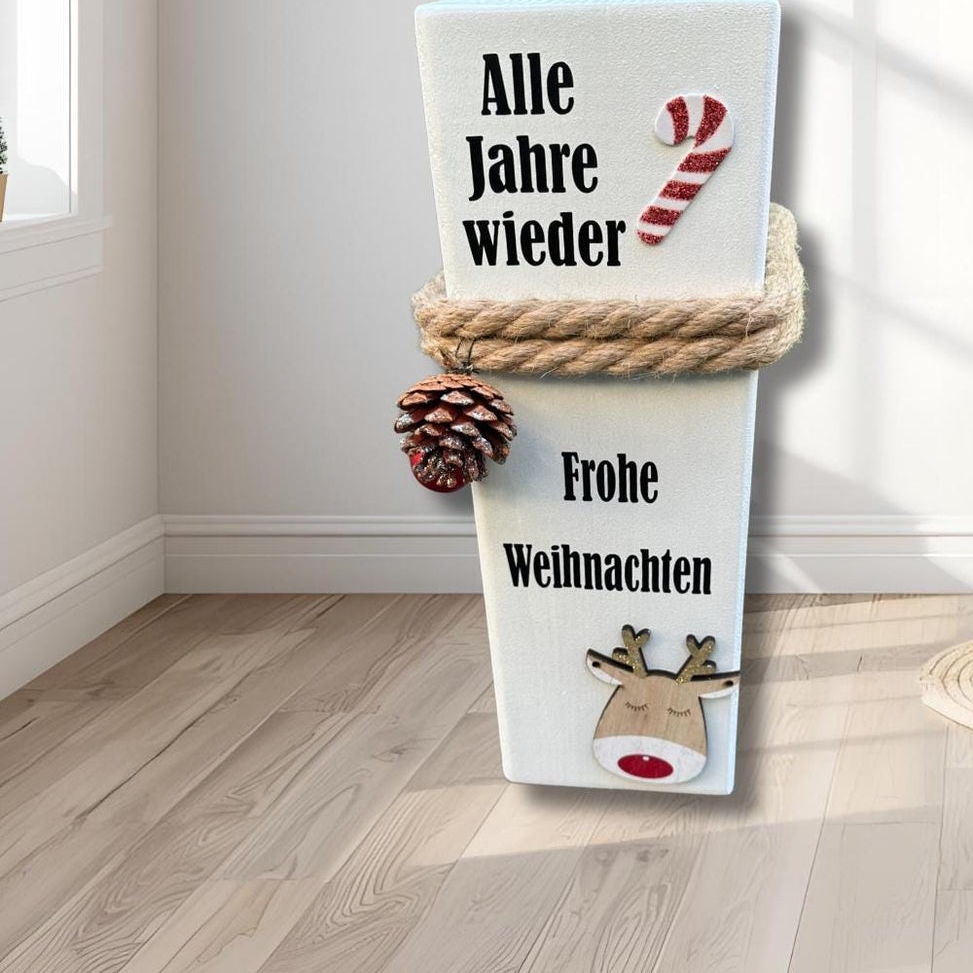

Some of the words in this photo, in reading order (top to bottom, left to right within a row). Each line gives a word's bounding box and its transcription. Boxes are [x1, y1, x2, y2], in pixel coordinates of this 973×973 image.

[481, 52, 575, 116] Alle
[466, 135, 598, 201] Jahre
[463, 210, 626, 267] wieder
[561, 451, 659, 504] Frohe
[503, 543, 712, 595] Weihnachten
